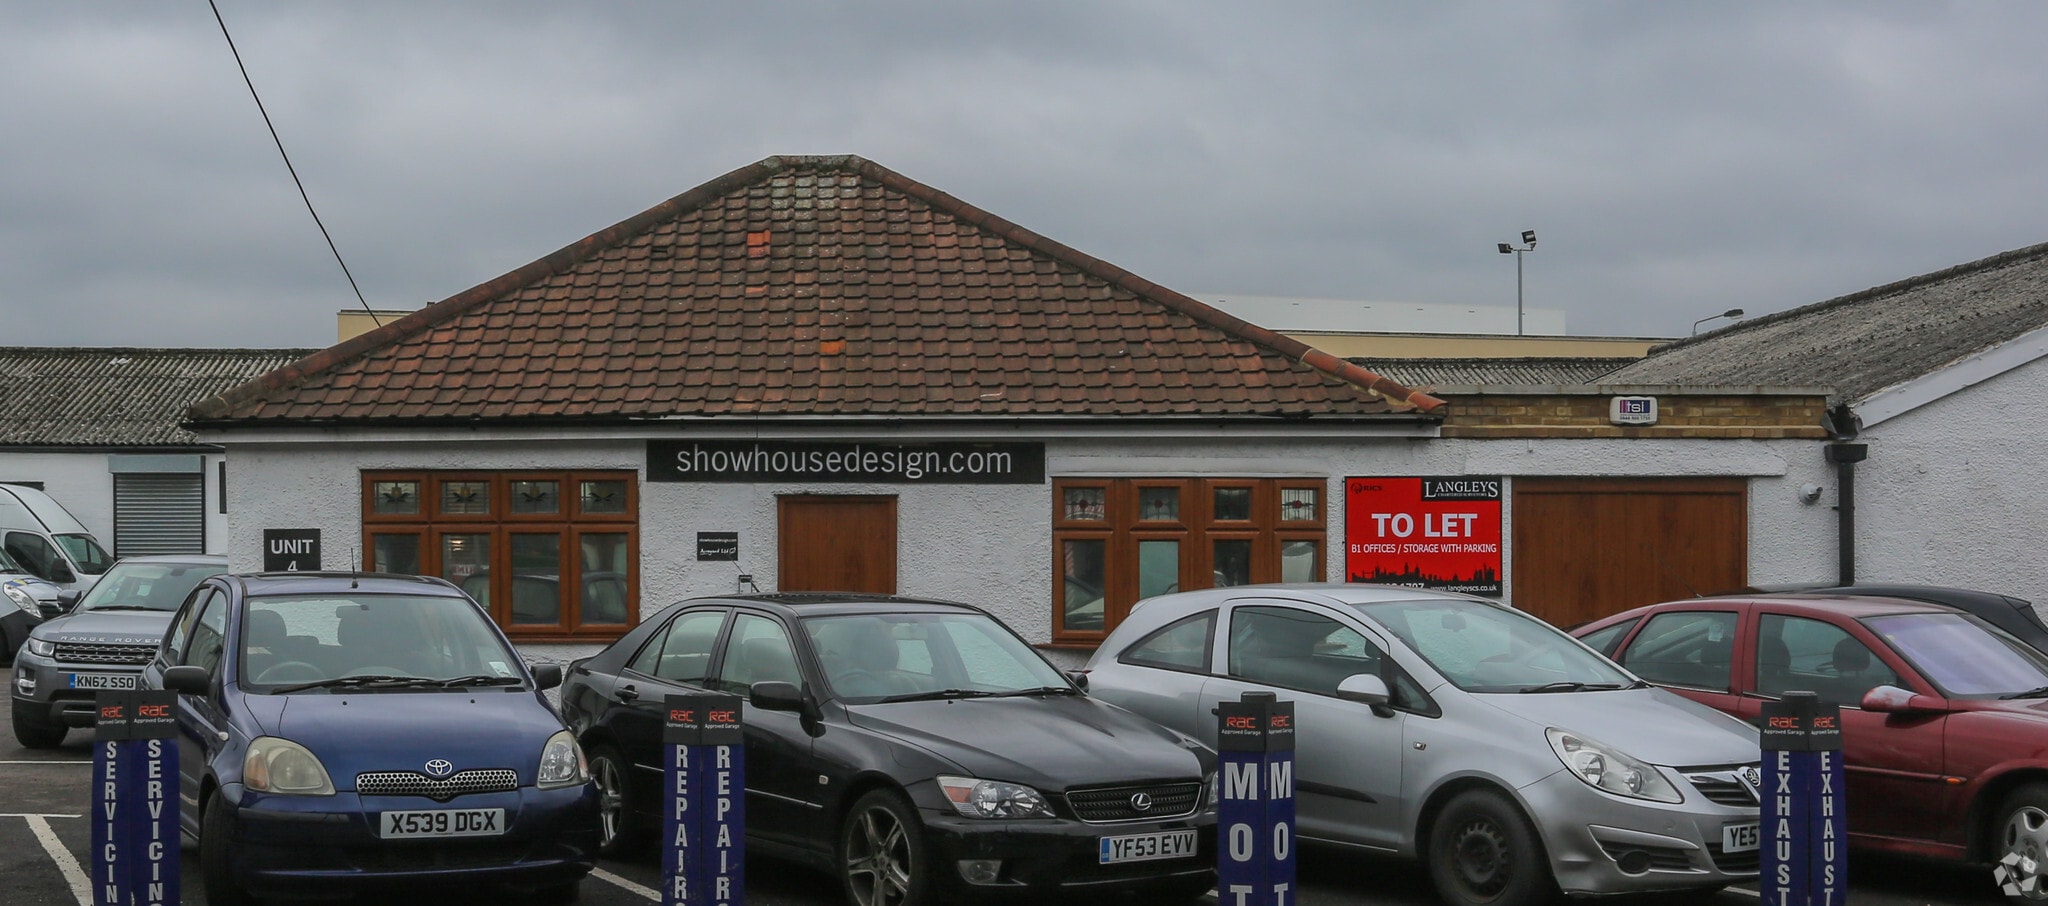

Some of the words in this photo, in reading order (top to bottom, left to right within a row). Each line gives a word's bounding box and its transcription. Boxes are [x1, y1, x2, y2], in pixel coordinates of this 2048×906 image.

[677, 444, 1012, 479] showhousedesign.com
[1425, 482, 1498, 497] LANGLEYS
[1372, 513, 1414, 538] TO
[1425, 514, 1478, 537] LET
[271, 539, 313, 554] UNIT
[1352, 544, 1361, 553] B1
[1364, 544, 1396, 553] OFFICES
[1397, 544, 1401, 554] /
[1404, 544, 1438, 553] STORAGE
[1441, 544, 1461, 553] WITH
[1464, 544, 1496, 553] PARKING
[288, 560, 298, 571] 4
[77, 675, 107, 688] KN62
[110, 676, 134, 688] SSO
[148, 739, 163, 906] SERVICIN
[390, 812, 448, 834] X539
[455, 811, 496, 832] DGX
[674, 744, 688, 906] REPAIR
[716, 745, 731, 906] REPAIR
[1224, 762, 1257, 906] MOT
[1270, 761, 1291, 906] MOT
[1776, 751, 1791, 906] EXHAUST
[1821, 751, 1835, 906] EXHAUST
[1113, 836, 1156, 858] YF53
[1161, 834, 1194, 854] EVV
[1730, 826, 1760, 847] YE5
